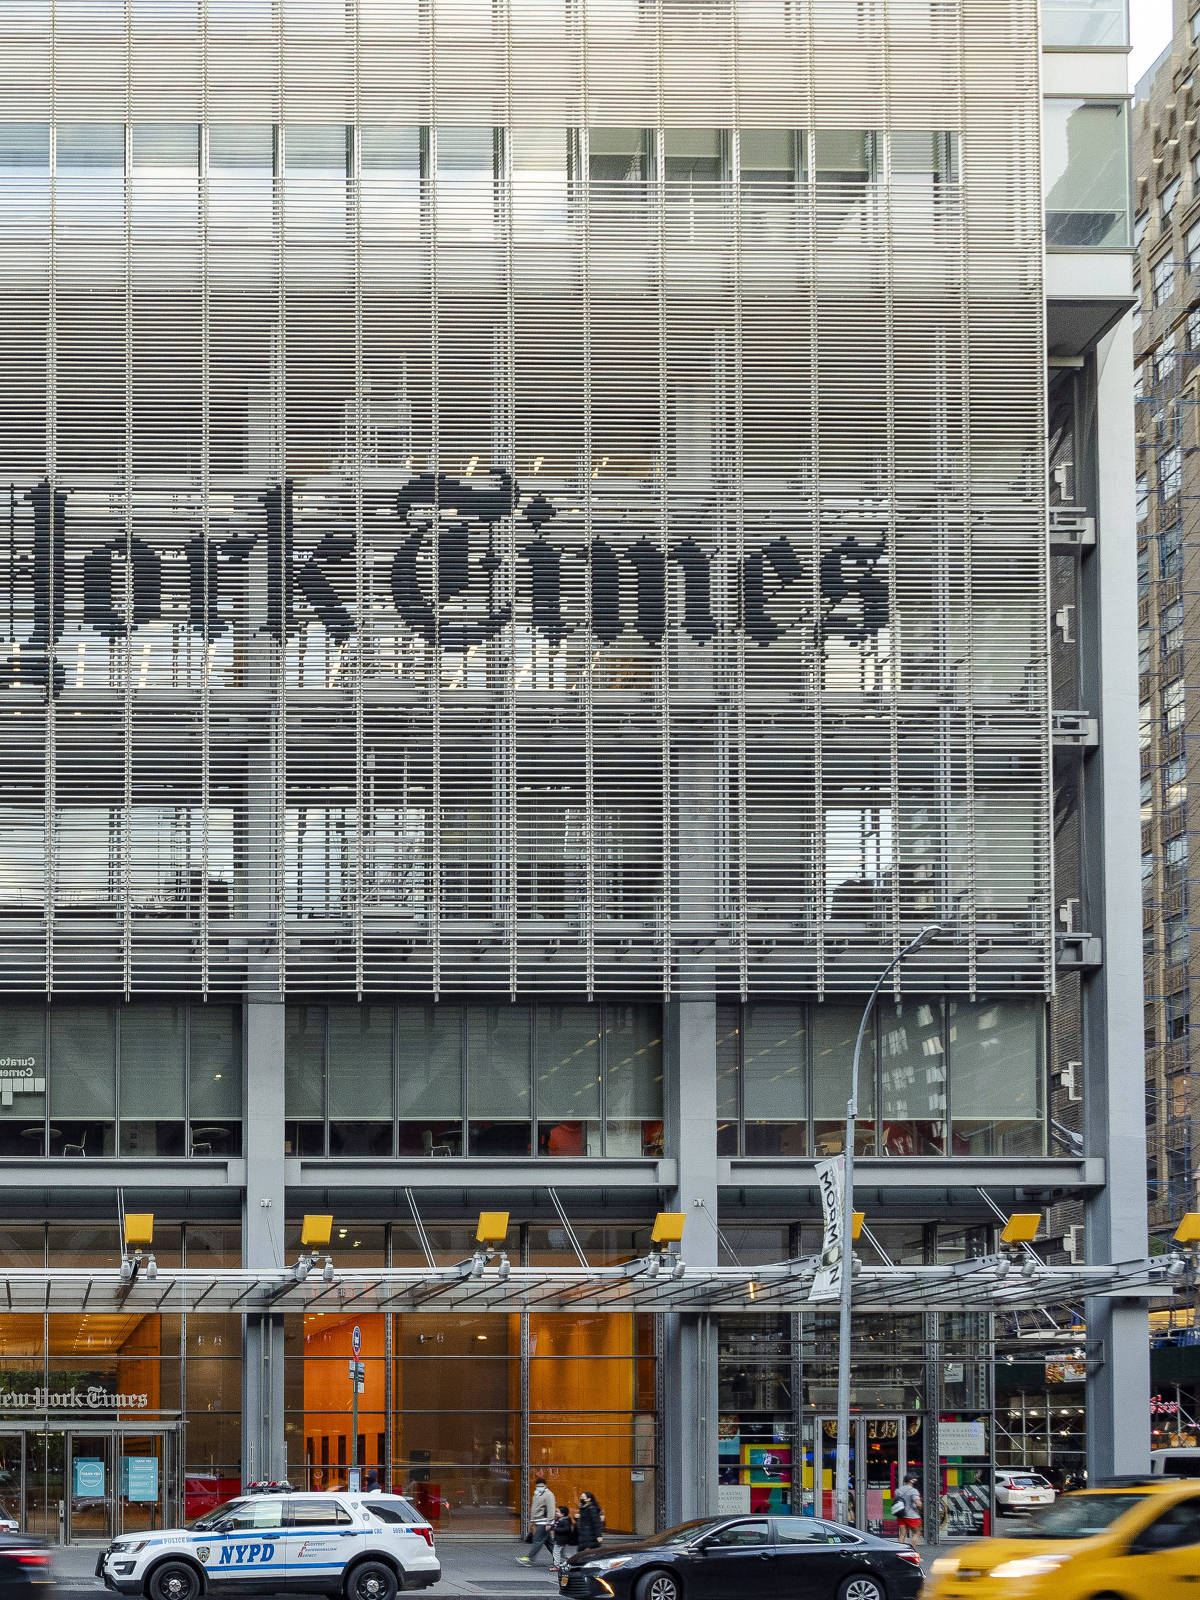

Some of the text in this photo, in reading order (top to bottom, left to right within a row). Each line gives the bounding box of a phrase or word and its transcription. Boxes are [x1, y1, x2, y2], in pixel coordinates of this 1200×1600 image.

[391, 467, 891, 650] Times
[31, 1386, 84, 1414] York
[86, 1385, 148, 1409] Times
[219, 1543, 275, 1565] NYPD
